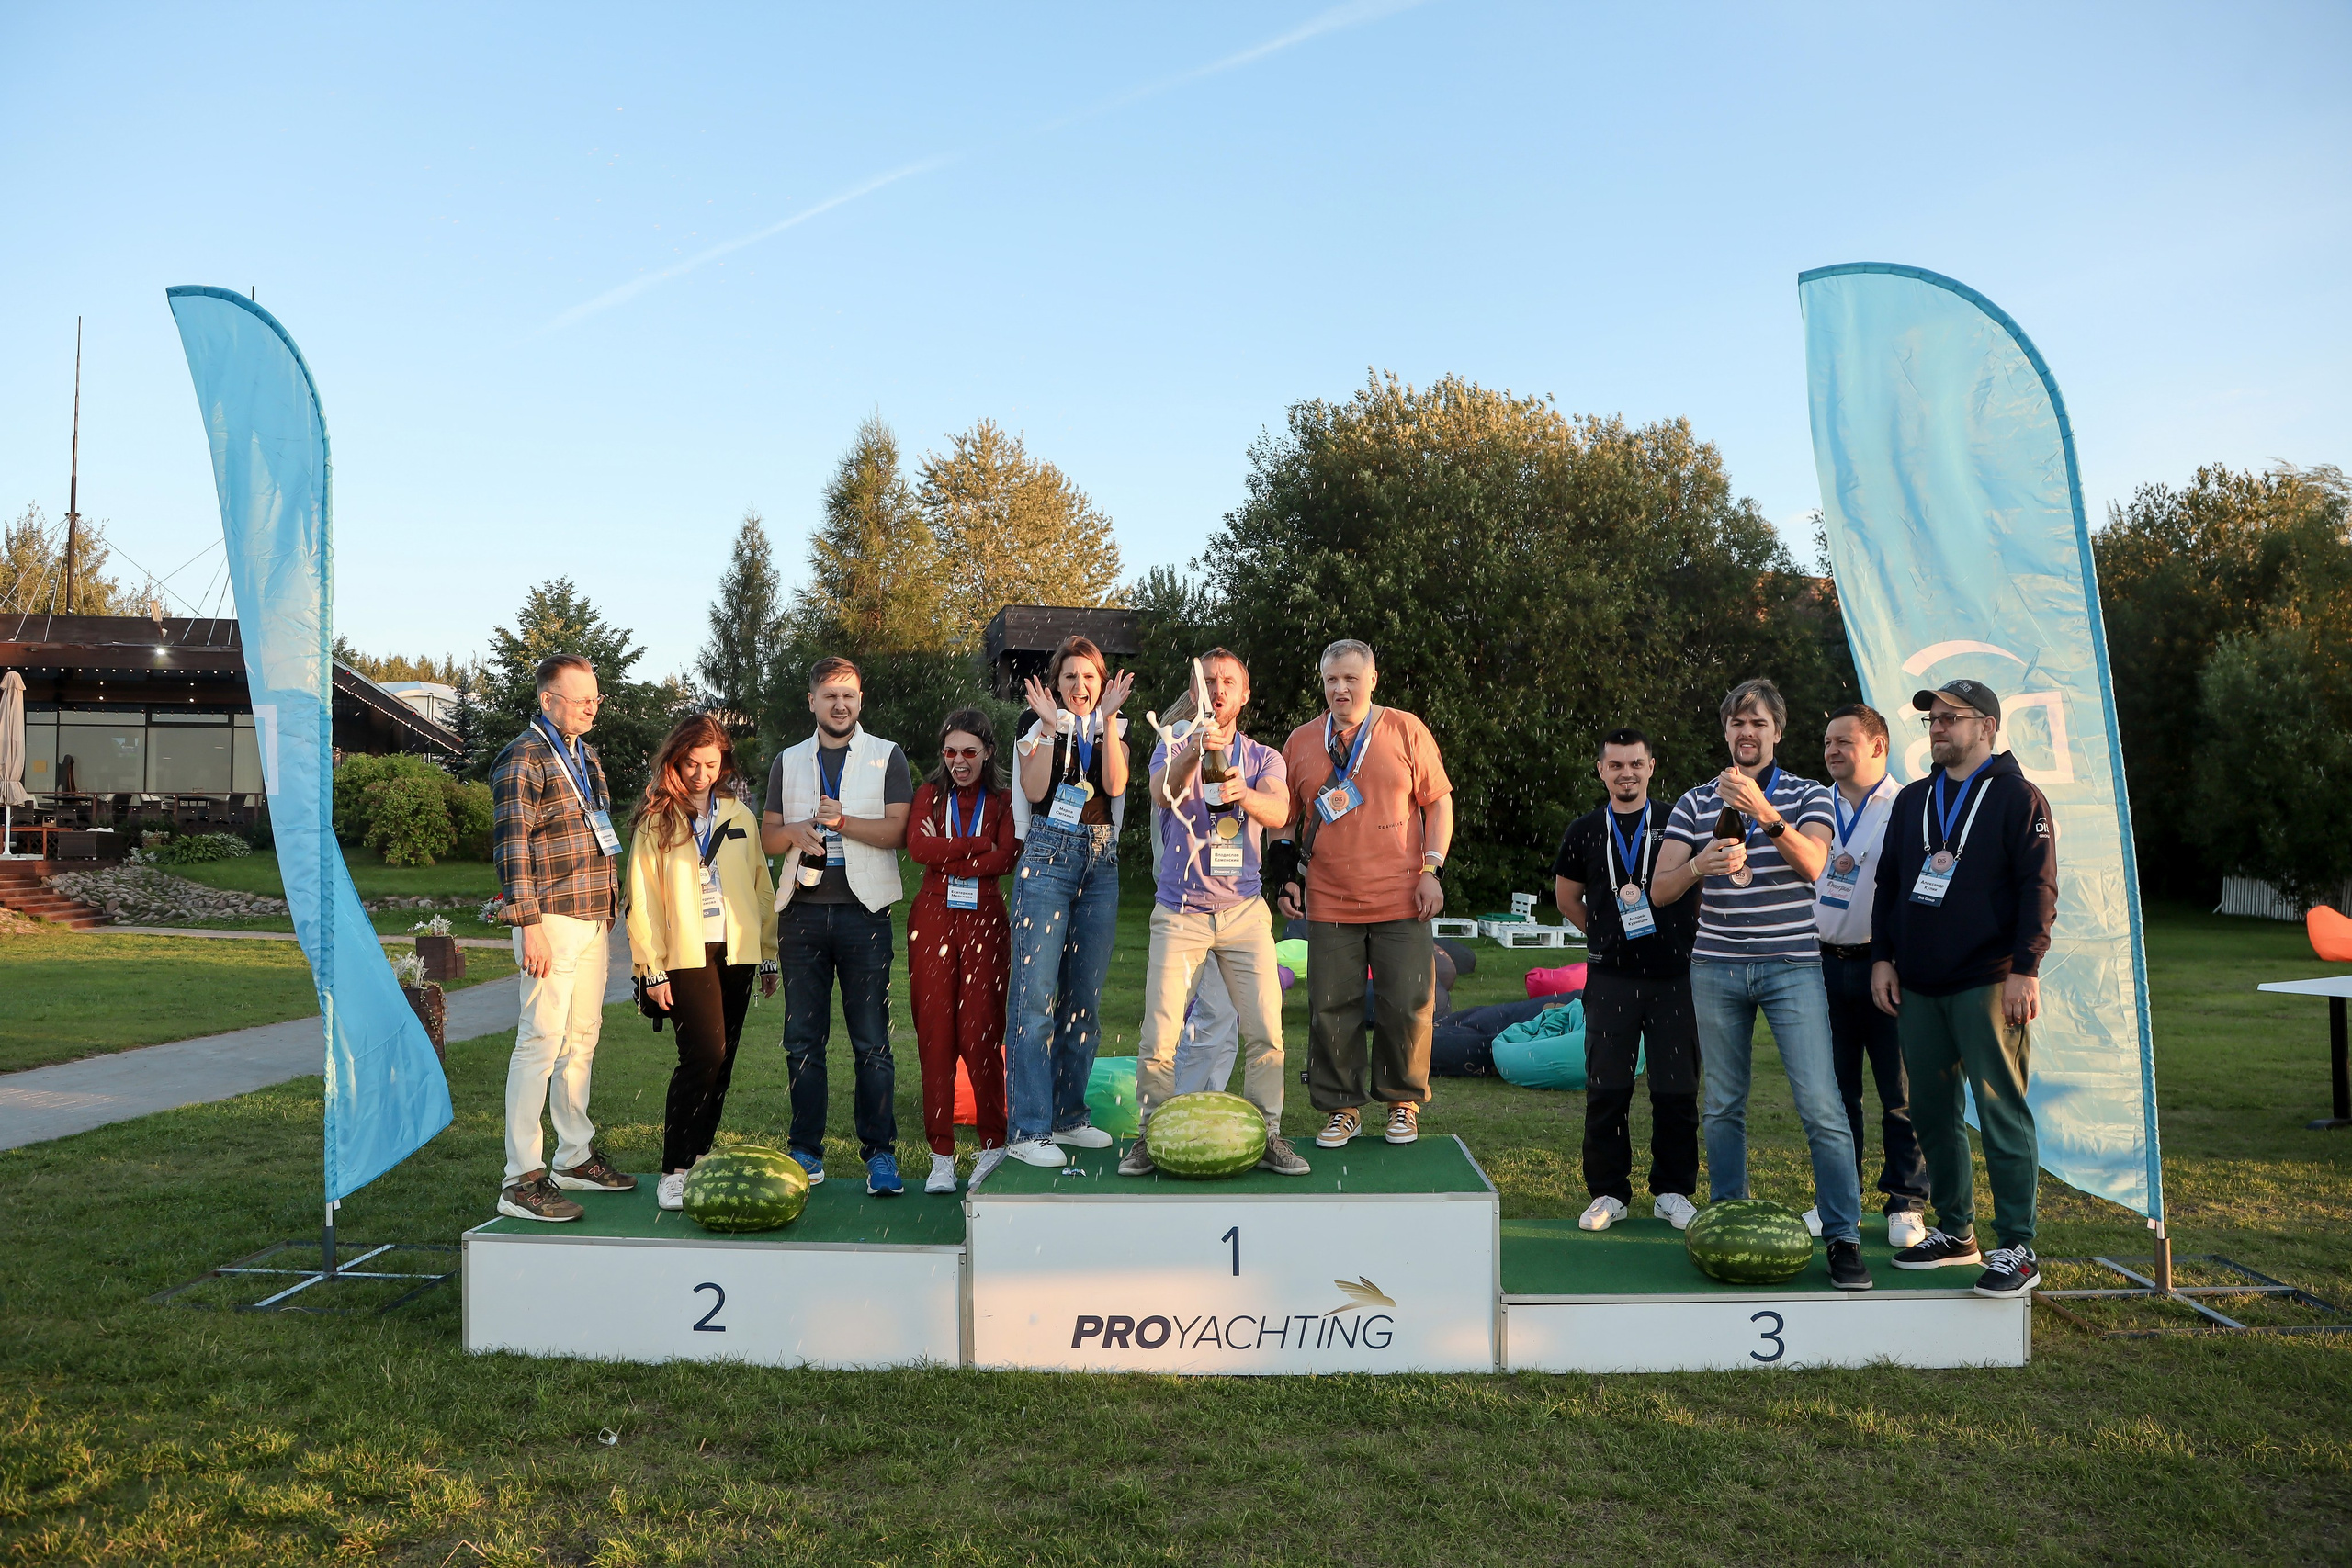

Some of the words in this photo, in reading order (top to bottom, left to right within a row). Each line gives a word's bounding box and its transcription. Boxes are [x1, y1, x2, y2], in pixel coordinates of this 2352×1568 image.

[1221, 1225, 1240, 1277] 1
[693, 1281, 727, 1332] 2
[1749, 1311, 1785, 1362] 3
